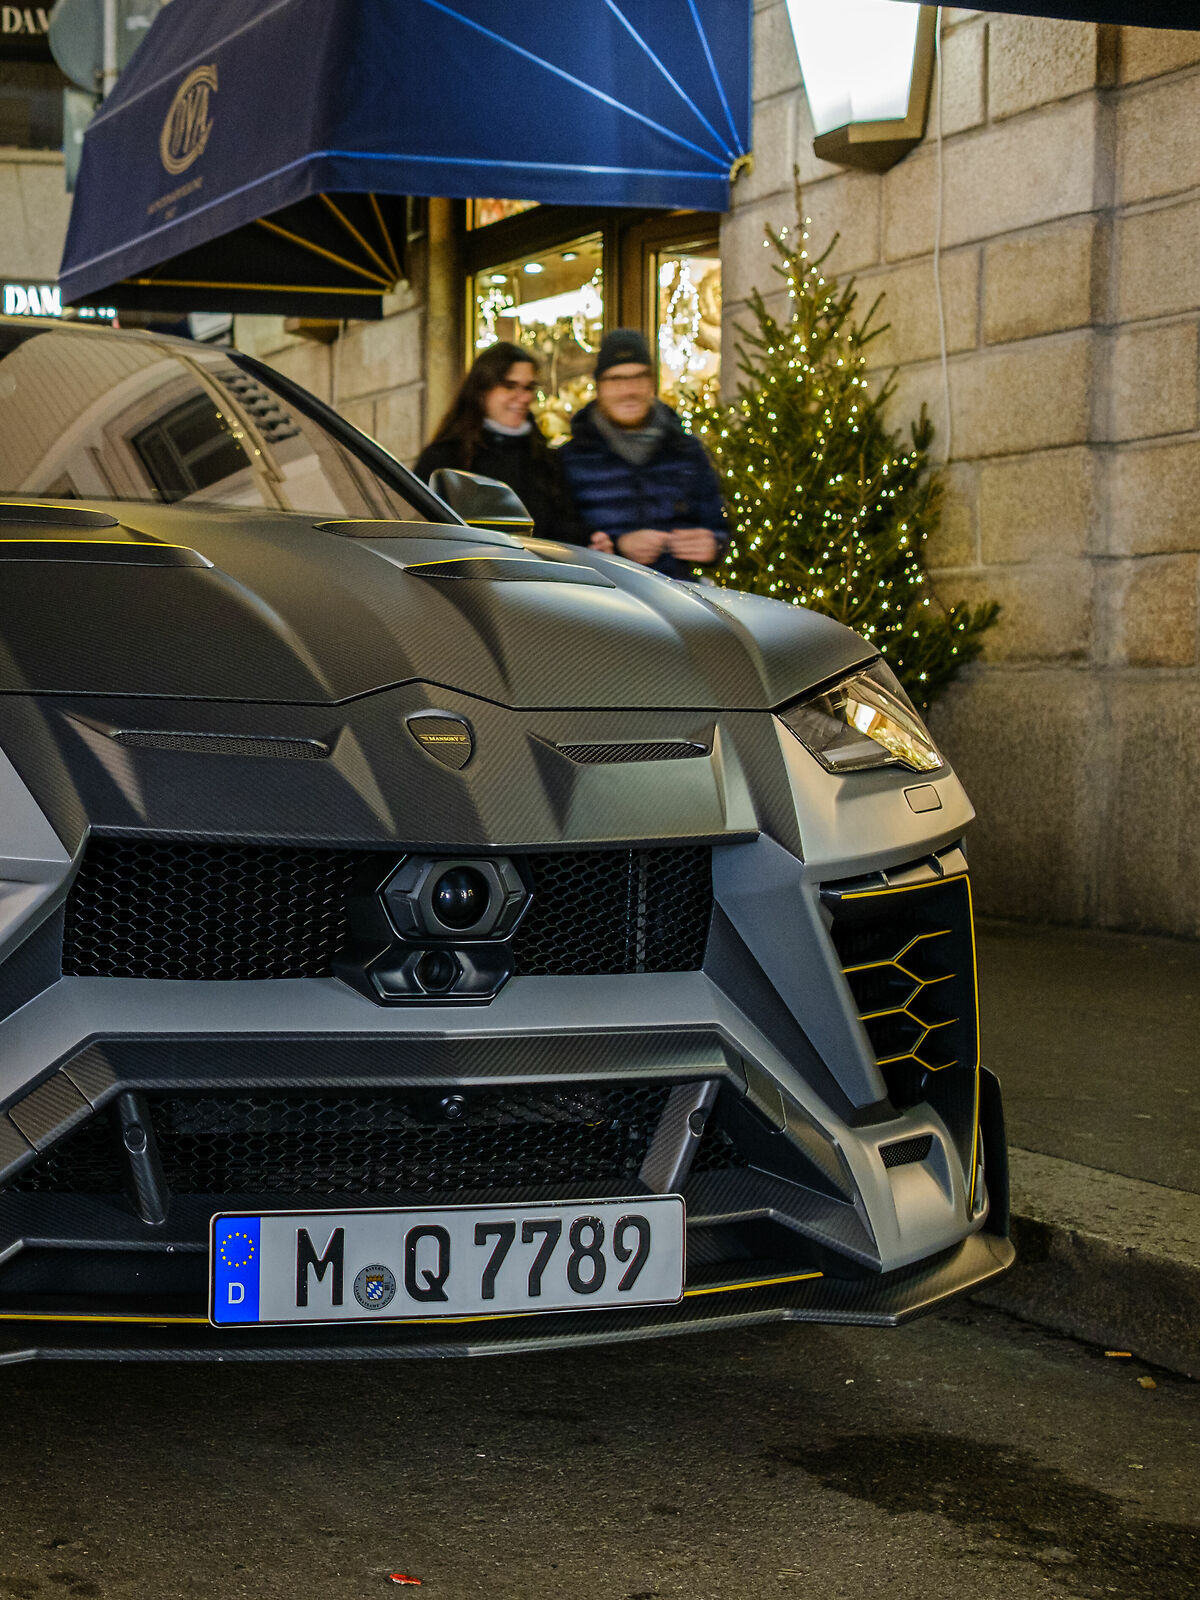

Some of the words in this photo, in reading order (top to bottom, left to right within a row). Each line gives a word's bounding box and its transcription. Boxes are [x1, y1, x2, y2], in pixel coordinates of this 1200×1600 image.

[3, 284, 62, 317] DAM
[295, 1227, 345, 1307] M
[403, 1224, 451, 1302] Q
[474, 1214, 652, 1299] 7789
[228, 1282, 245, 1304] D
